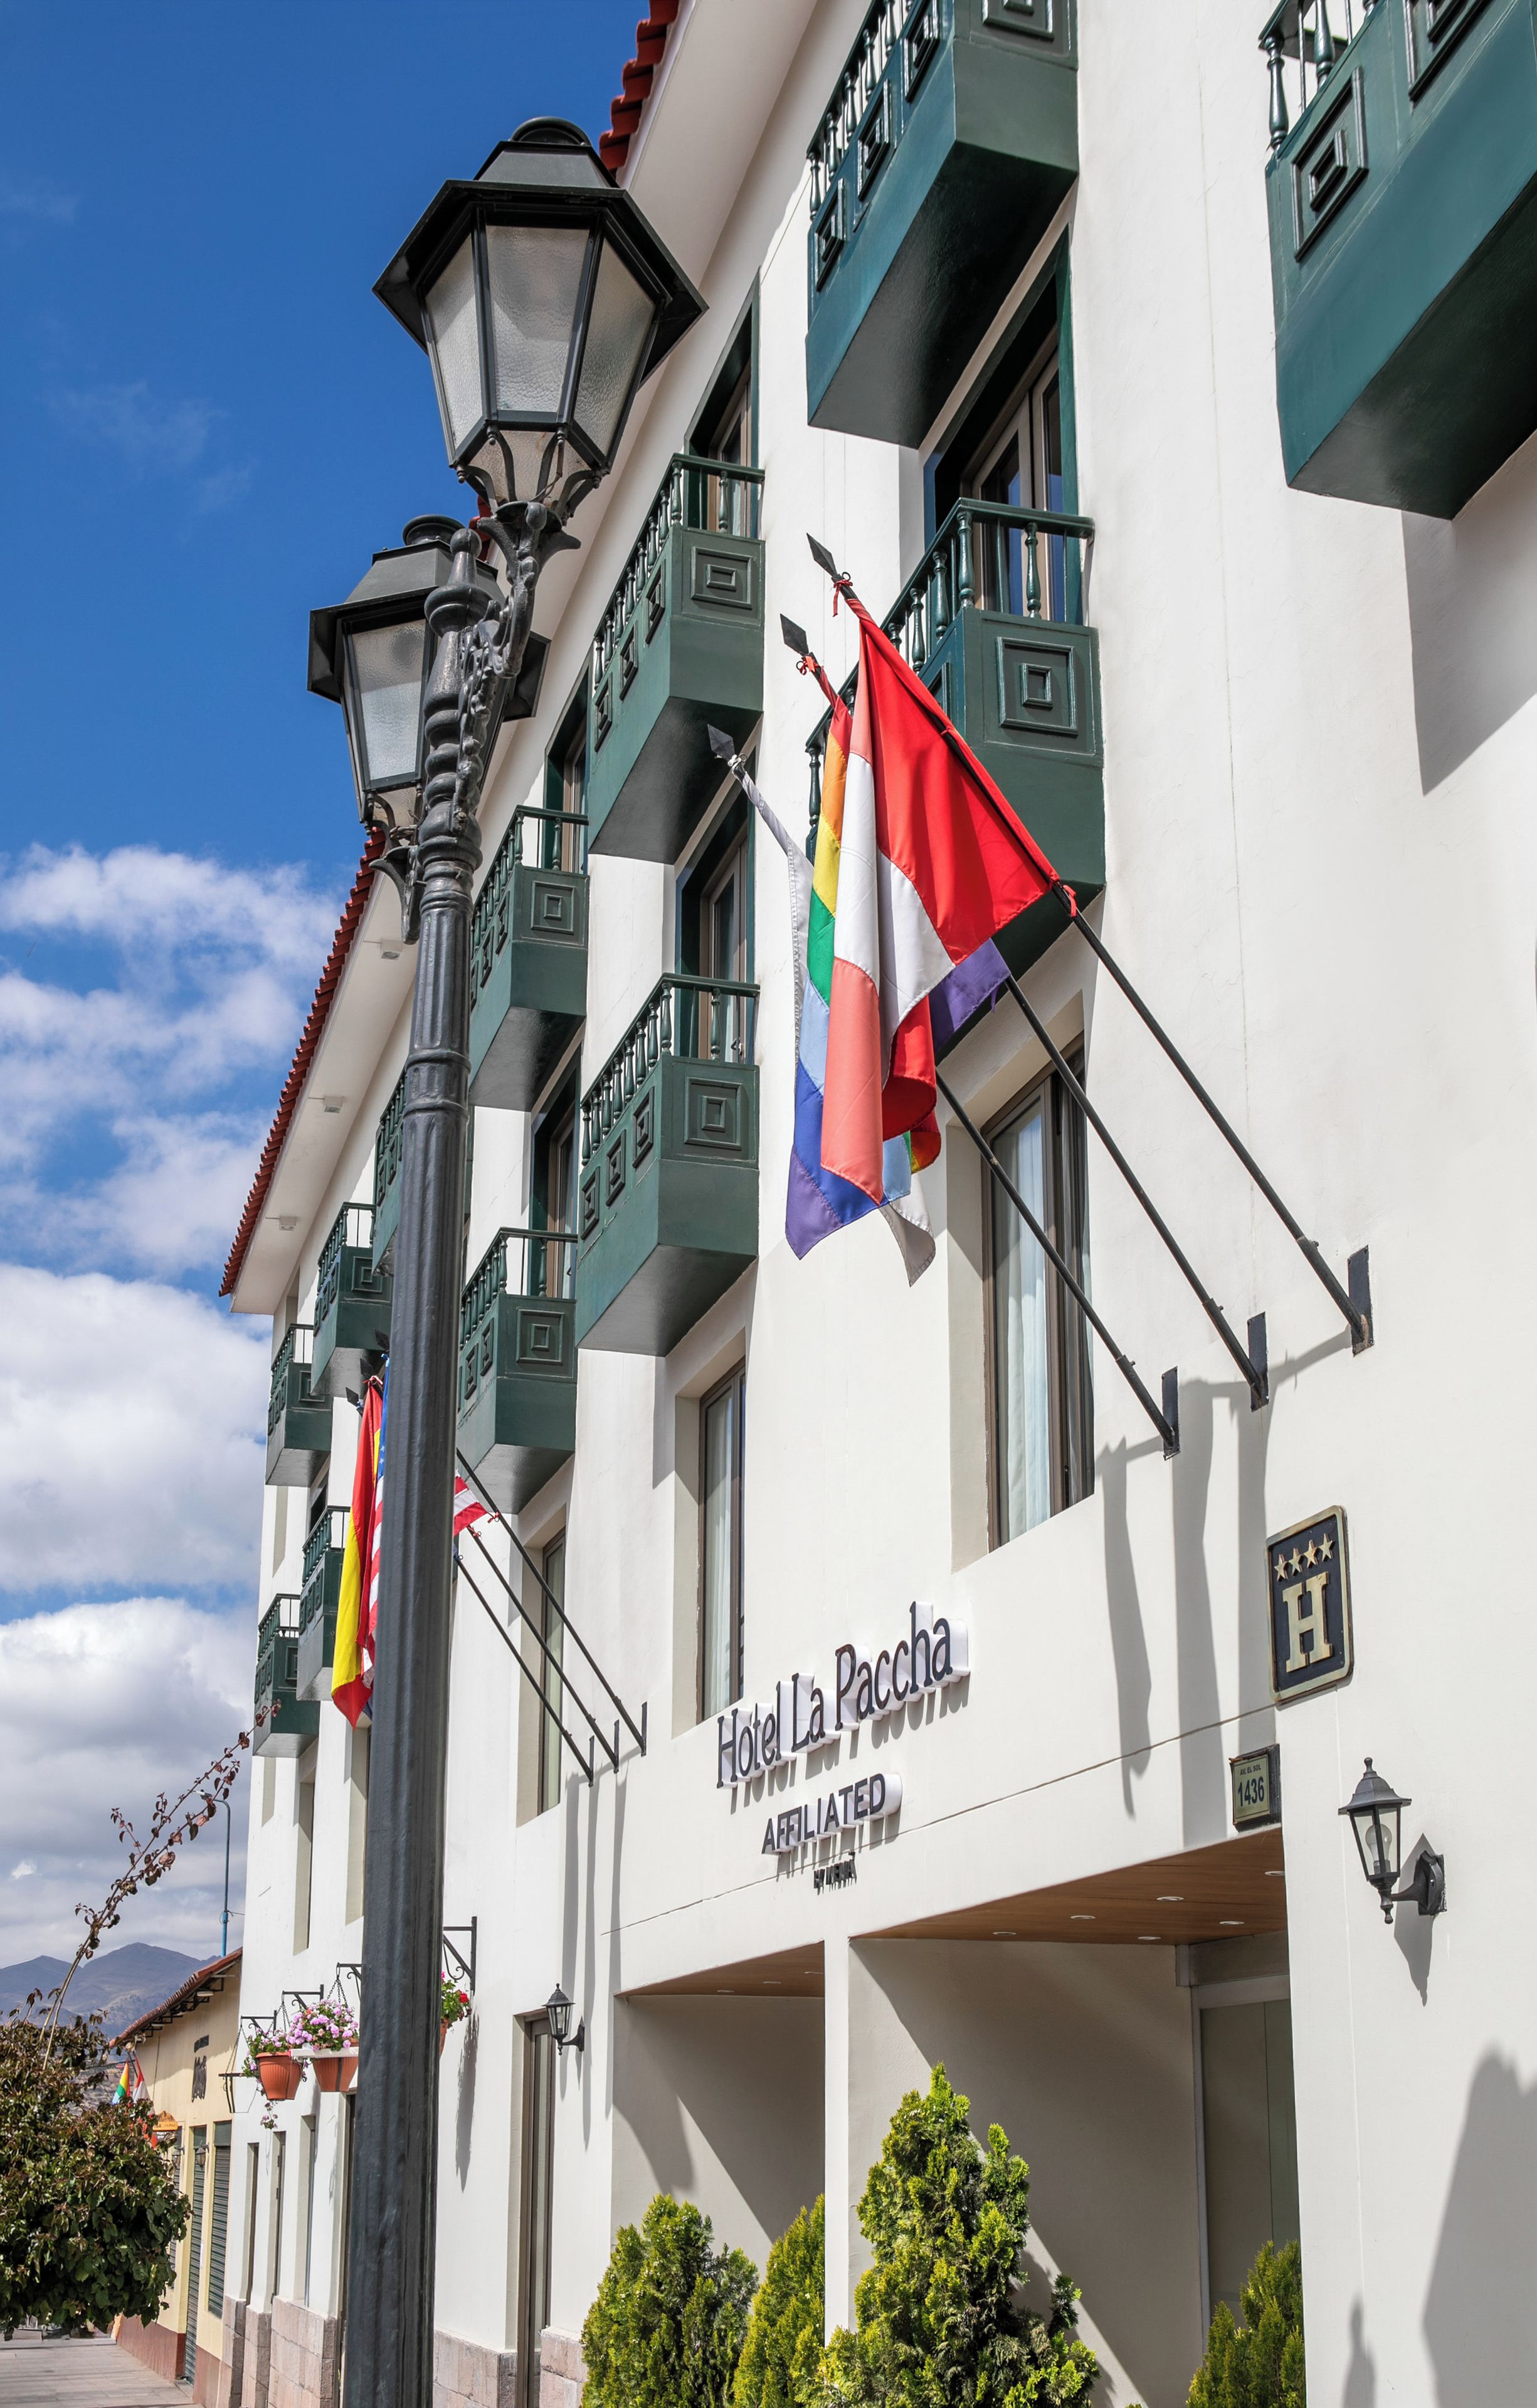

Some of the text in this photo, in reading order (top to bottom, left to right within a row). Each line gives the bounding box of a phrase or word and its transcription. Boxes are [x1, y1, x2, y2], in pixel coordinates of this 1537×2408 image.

[1283, 1571, 1333, 1672] H
[717, 1601, 953, 1788] Hotel La Paccha
[761, 1773, 885, 1854] AFFILIATED
[1238, 1776, 1265, 1807] 1436
